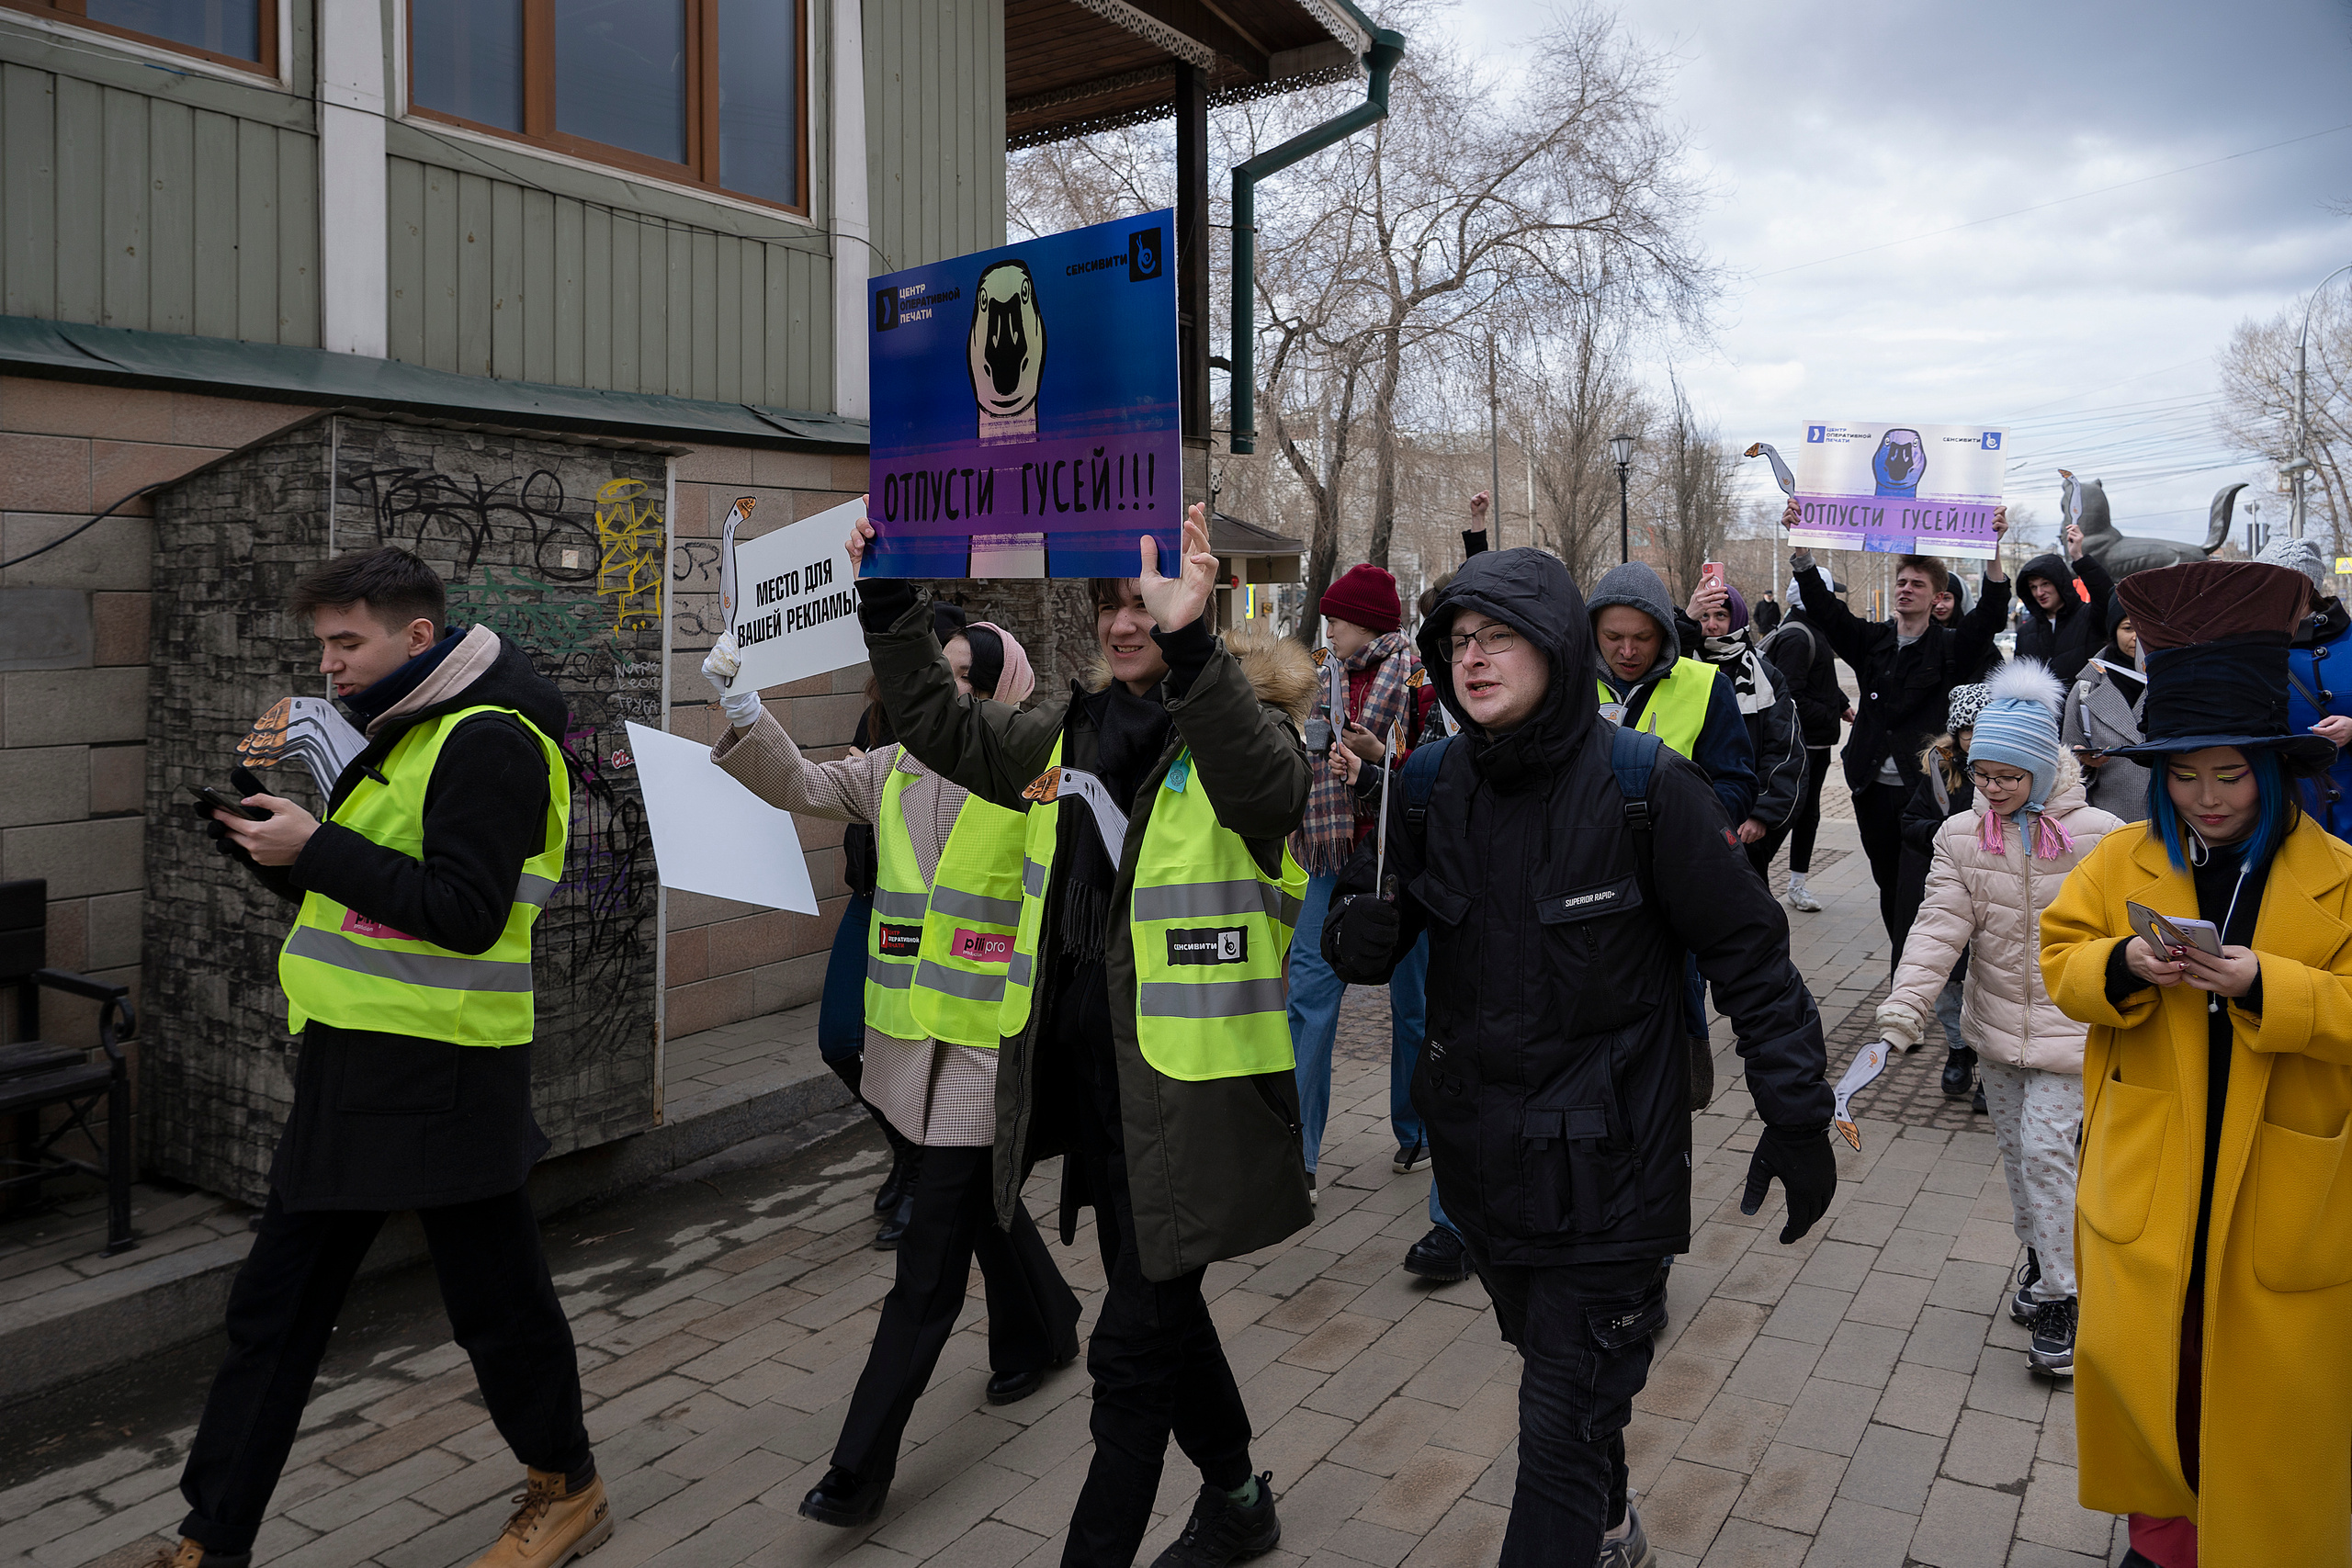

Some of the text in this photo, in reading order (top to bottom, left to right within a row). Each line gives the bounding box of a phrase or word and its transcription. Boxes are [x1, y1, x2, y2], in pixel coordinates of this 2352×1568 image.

[1066, 254, 1128, 276] СЕНСИВИТИ
[899, 283, 926, 299] ЦЕНТР
[900, 287, 961, 311] ОПЕРАТИВНОЙ
[900, 308, 933, 324] ПЕЧАТИ
[884, 446, 1156, 523] ОТПУСТИ ГУСЕЙ!!!
[1804, 502, 1986, 534] ОТПУСТИ ГУСЕЙ!!!
[756, 558, 833, 608] МЕСТО ДЛЯ
[737, 607, 782, 649] ВАШЕЙ
[786, 587, 857, 635] РЕКЛАМЫ
[1565, 890, 1615, 907] SUPERIOR RAPID+
